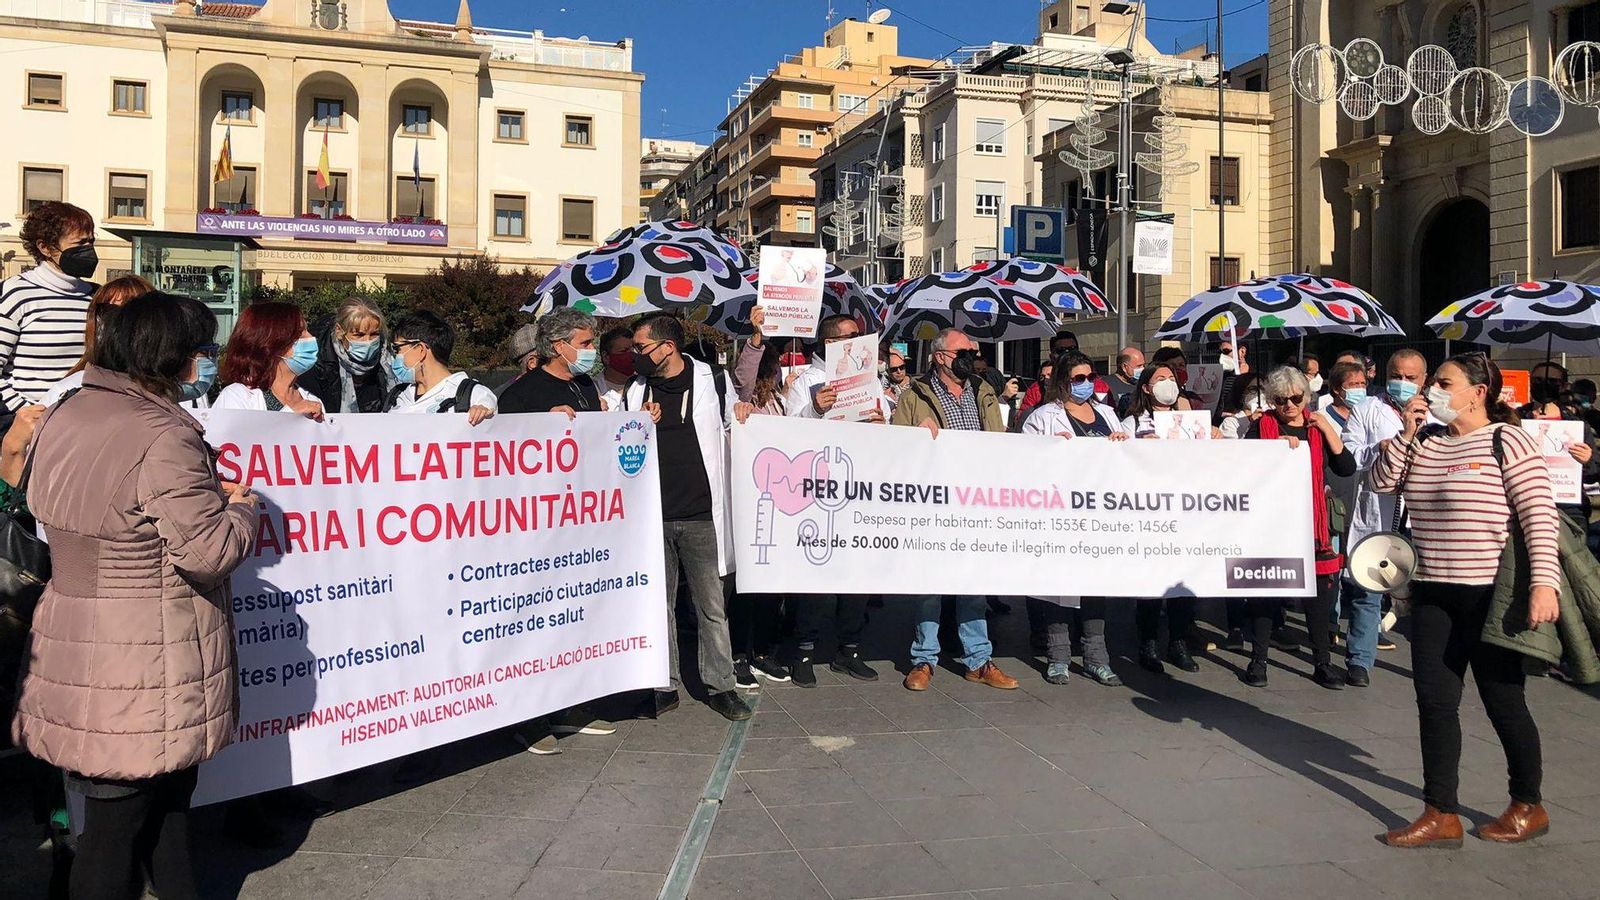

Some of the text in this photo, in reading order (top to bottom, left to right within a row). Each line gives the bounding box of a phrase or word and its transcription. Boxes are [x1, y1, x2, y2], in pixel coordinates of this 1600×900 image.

[221, 220, 245, 230] ANTE
[248, 222, 265, 230] LAS
[267, 222, 320, 233] VIOLENCIAS
[322, 225, 336, 233] NO
[338, 226, 365, 235] MIRES
[367, 227, 374, 235] A
[376, 228, 400, 236] OTRO
[402, 229, 425, 238] LADO
[1025, 212, 1053, 250] P
[142, 265, 151, 273] LA
[257, 251, 325, 260] BDELEGACION
[357, 255, 404, 263] GOBIERNO
[833, 401, 852, 409] ANIDAD
[217, 430, 579, 486] SALVEM L'ATENCIÓ
[802, 478, 1250, 512] PER UN SERVEI VALENCIÀ DE SALUT DIGNE
[254, 484, 625, 557] ÀRIA I COMUNITÀRIA
[854, 511, 1178, 533] Despesa per habitant: Sanitat: 1553€ Deute: 1456€
[831, 534, 847, 548] de
[851, 536, 899, 549] 50.000
[902, 536, 946, 551] Milions
[950, 538, 967, 552] de
[970, 538, 1008, 553] deute
[1012, 539, 1066, 558] il·legítim
[1069, 541, 1123, 559] ofeguen
[1128, 543, 1139, 555] el
[1144, 543, 1182, 558] poble
[1186, 543, 1242, 556] valencià
[461, 547, 610, 582] Contractes estables
[1234, 566, 1296, 580] Decidim
[232, 574, 393, 613] essupost sanitàri
[460, 571, 649, 618] Participació ciutadana als
[238, 615, 304, 646] mària)
[462, 606, 585, 644] centres de salut
[240, 634, 425, 688] tes per professional
[413, 672, 486, 702] AUDITORIA
[488, 670, 492, 684] I
[494, 646, 583, 682] CANCEL·LACIÓ
[585, 643, 604, 660] DEL
[606, 636, 652, 655] DEUTE.
[342, 693, 498, 746] HISENDA VALENCIANA.
